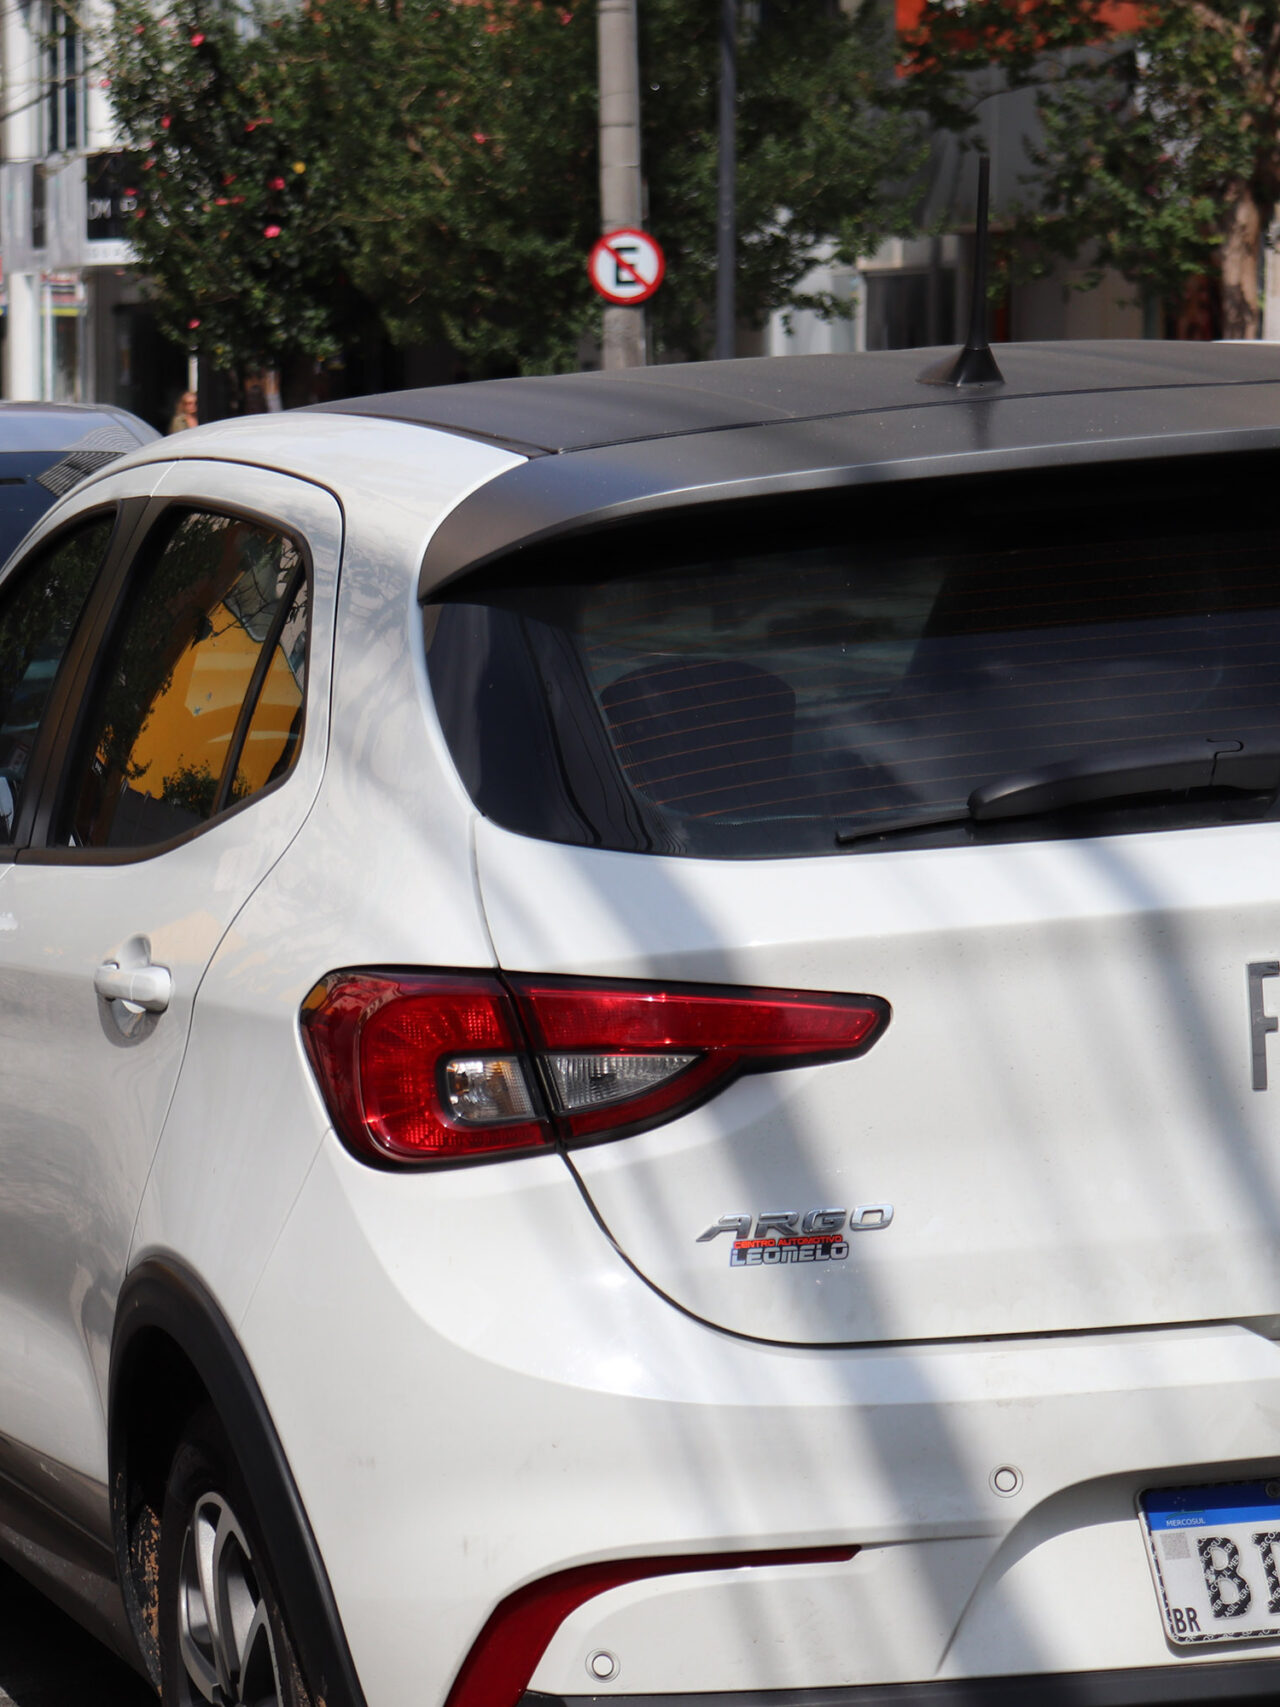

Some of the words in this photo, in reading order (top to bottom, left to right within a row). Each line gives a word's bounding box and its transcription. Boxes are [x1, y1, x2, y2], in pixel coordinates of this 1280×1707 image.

[696, 1204, 894, 1243] ARGO
[734, 1239, 776, 1249] CENTRO
[778, 1234, 843, 1246] AUTOMOTIVO
[1166, 1517, 1206, 1527] MERCOSUL
[1172, 1607, 1201, 1634] BR
